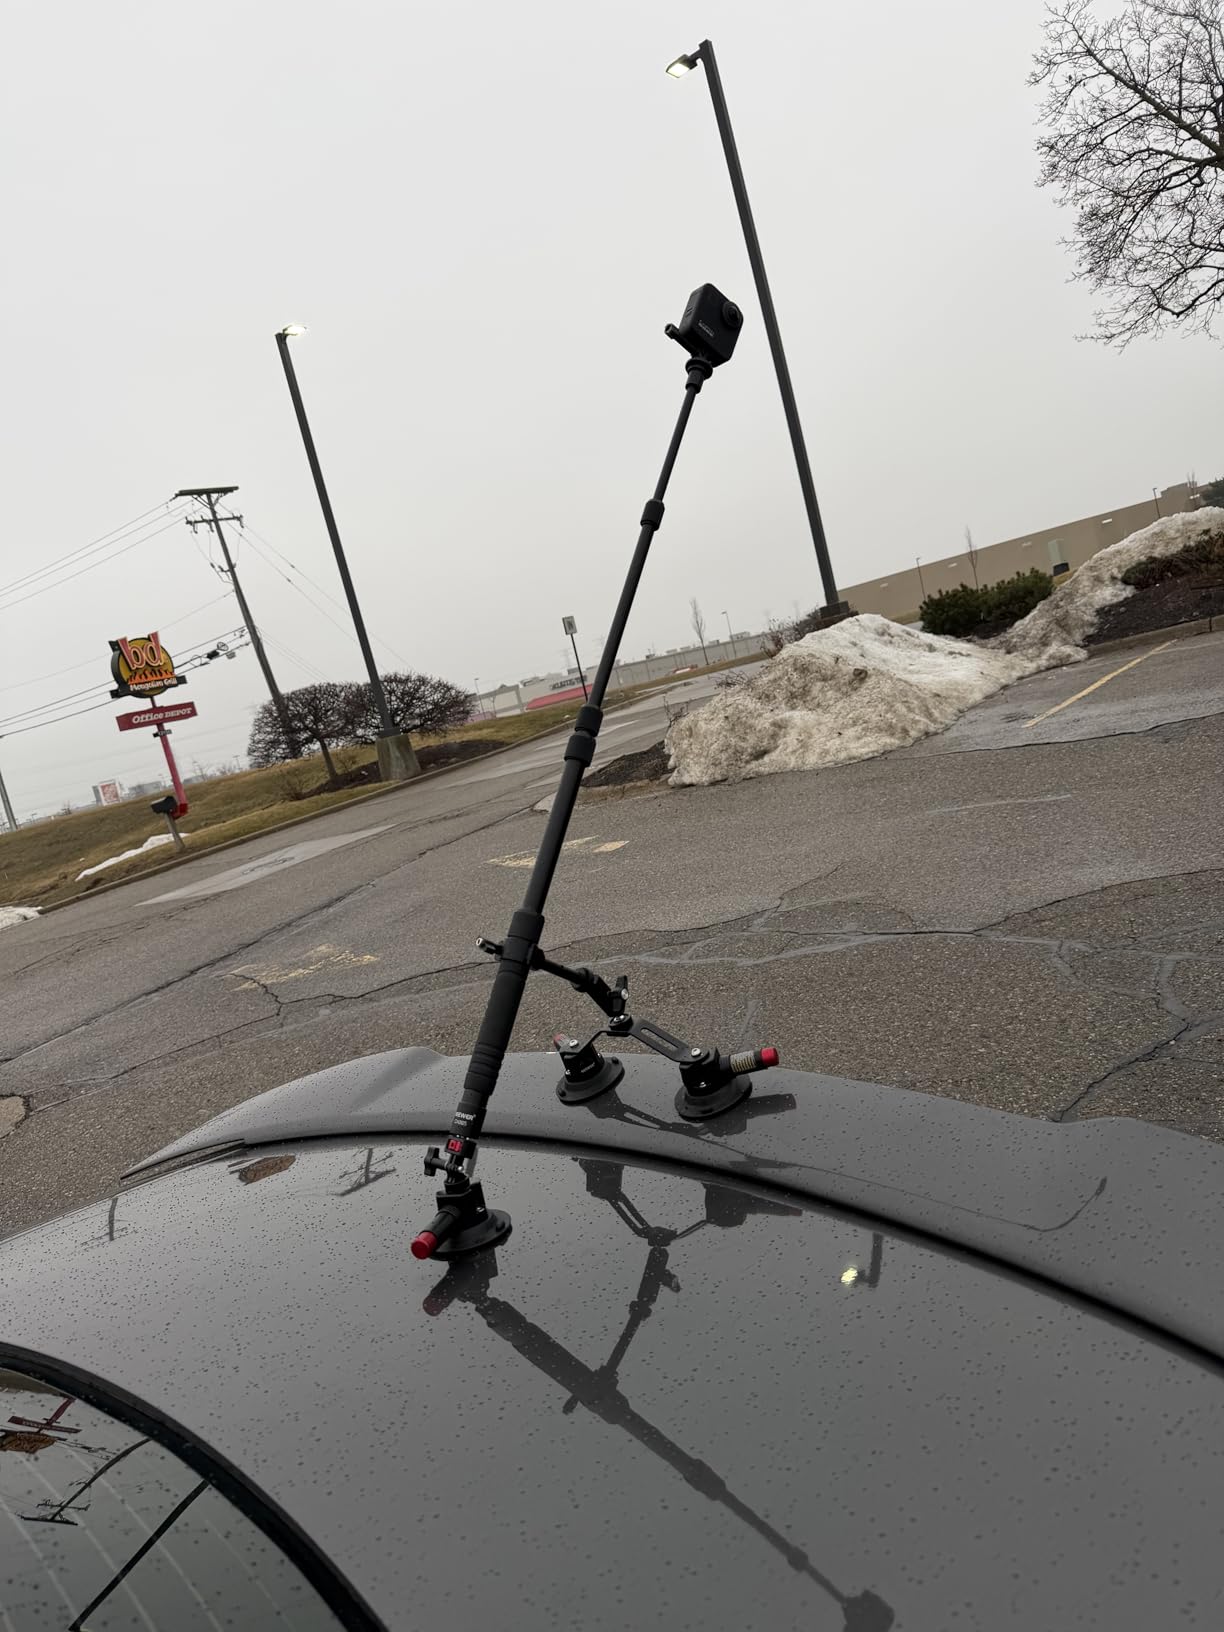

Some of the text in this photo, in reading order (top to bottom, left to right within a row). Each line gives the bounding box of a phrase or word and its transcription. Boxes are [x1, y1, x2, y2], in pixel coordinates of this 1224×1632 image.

[118, 631, 164, 670] bd
[130, 681, 163, 691] Mongolian
[132, 707, 193, 724] Office DEPOT
